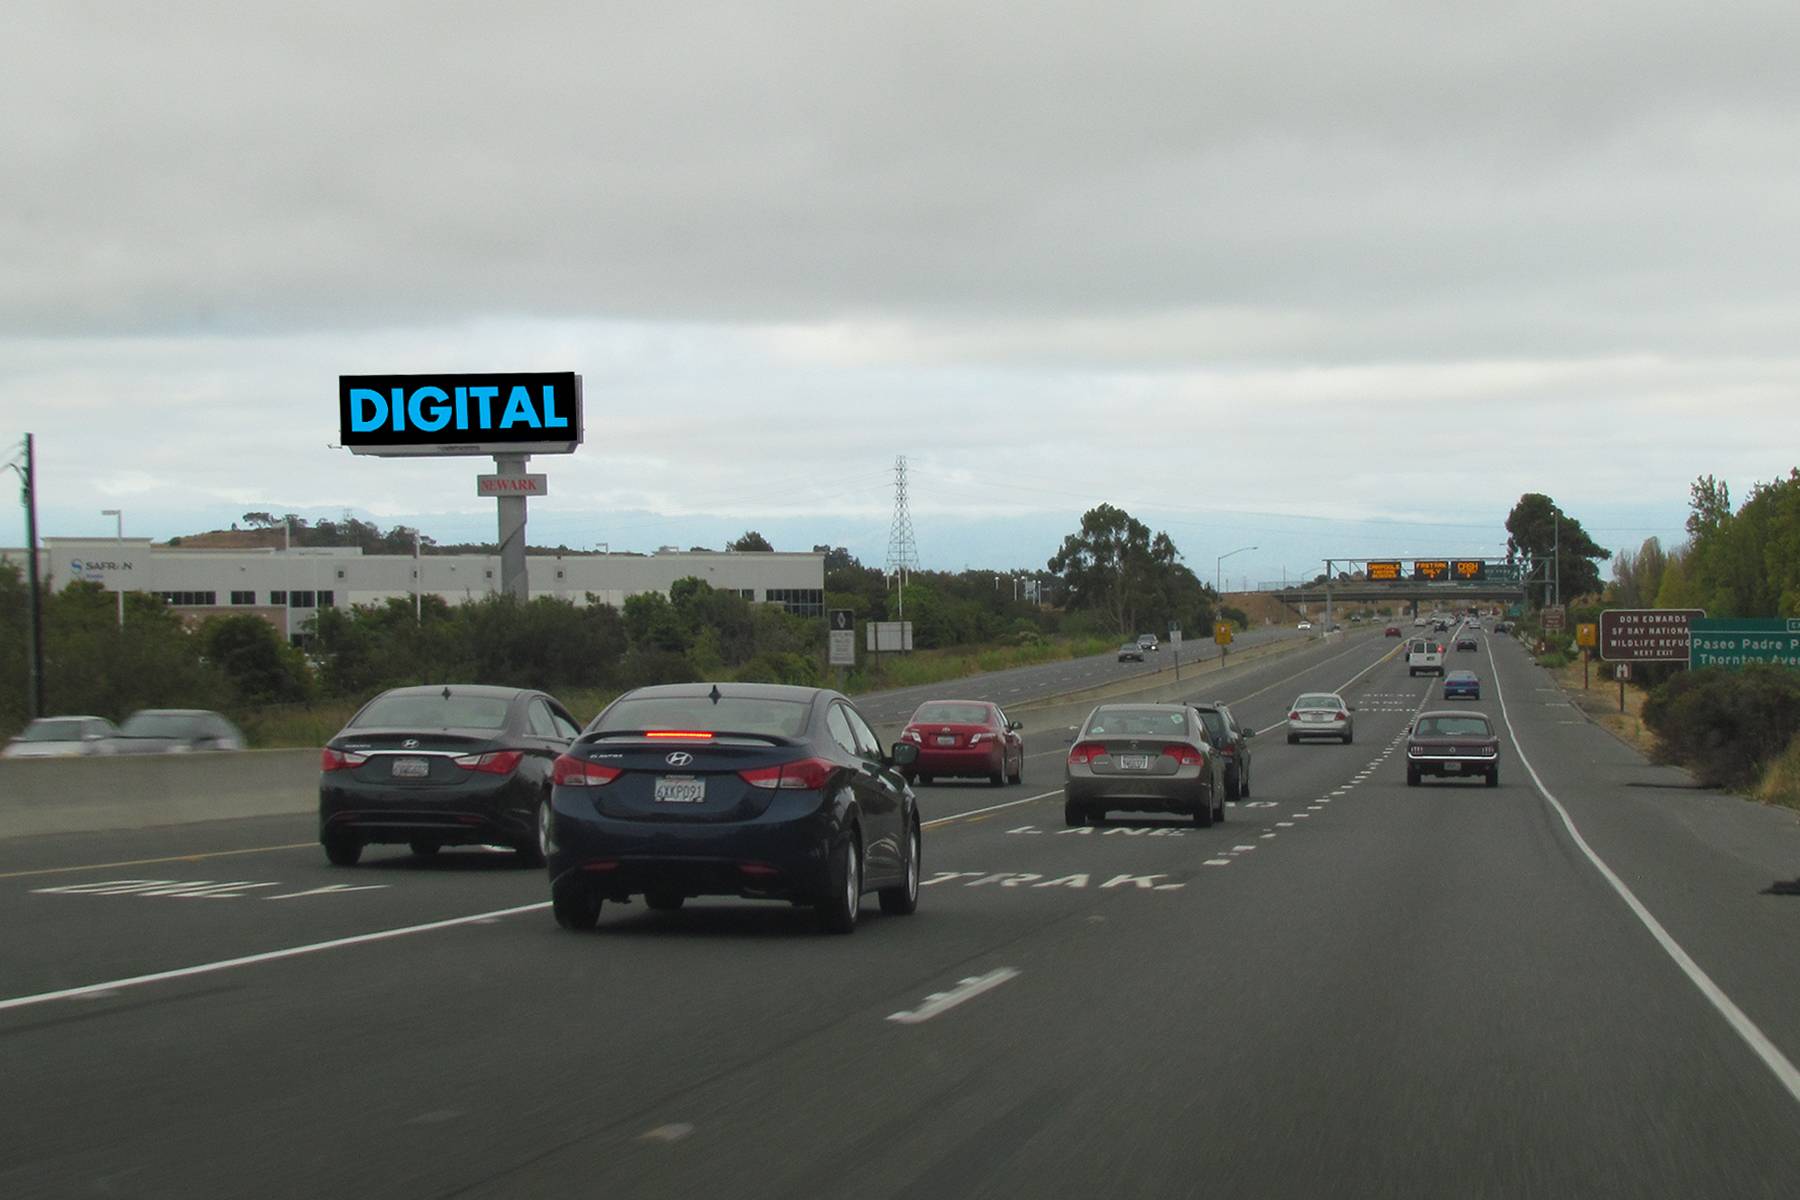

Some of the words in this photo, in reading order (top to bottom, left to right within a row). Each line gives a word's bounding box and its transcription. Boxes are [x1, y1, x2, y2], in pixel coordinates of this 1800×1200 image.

[349, 385, 568, 432] DIGITAL
[481, 479, 537, 491] NEWARK
[85, 561, 133, 570] SAFRN
[1619, 615, 1638, 623] DON
[1643, 615, 1687, 623] EDWARDS
[1611, 627, 1623, 635] SF
[1627, 627, 1645, 635] BAY
[1649, 627, 1690, 635] NATIONA
[1611, 639, 1656, 647] WILDLIFE
[1659, 639, 1690, 647] REFUG
[1693, 639, 1735, 649] Paseo
[1742, 639, 1783, 649] Padre
[1790, 639, 1800, 649] P
[1700, 653, 1763, 664] Thornton
[1771, 654, 1800, 665] Ave
[919, 871, 1169, 888] TRAK
